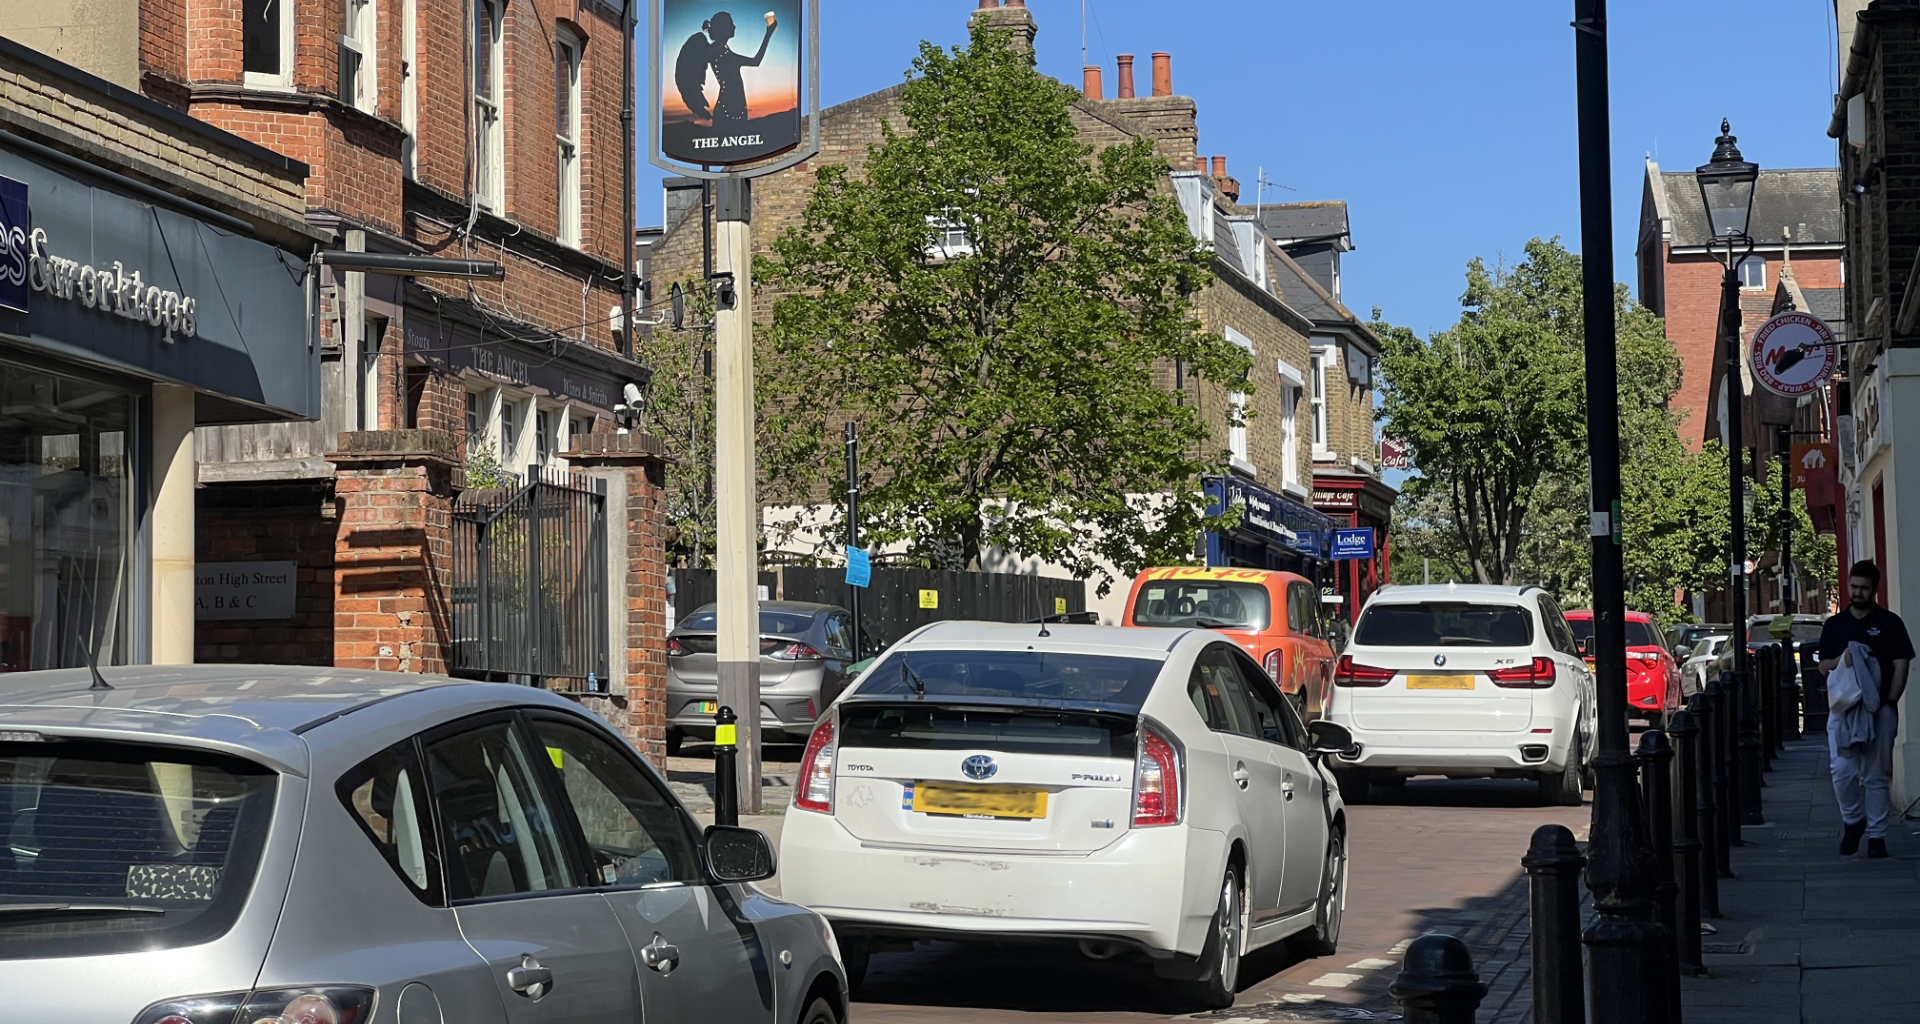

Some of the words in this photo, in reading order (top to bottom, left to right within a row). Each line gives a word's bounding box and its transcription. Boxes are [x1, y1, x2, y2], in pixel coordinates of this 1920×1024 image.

[692, 138, 719, 149] THE
[720, 134, 764, 147] ANGEL
[1775, 315, 1812, 327] CHICKEN
[407, 328, 431, 350] Stouts
[1757, 322, 1776, 344] FRIED
[1815, 324, 1828, 339] PIRI
[471, 346, 494, 374] THE
[496, 354, 531, 386] ANGEL
[1754, 351, 1763, 369] RIBS
[1760, 369, 1775, 385] BBQ
[563, 378, 581, 397] Wines
[582, 383, 587, 400] &
[588, 384, 608, 405] Spirits
[1778, 384, 1804, 392] WRAP
[1383, 454, 1405, 467] Cafe
[1336, 491, 1354, 502] Cafe
[1337, 533, 1366, 546] Lodge
[195, 576, 215, 586] ton
[219, 572, 249, 588] High
[252, 572, 287, 585] Street
[214, 595, 224, 609] B
[228, 595, 240, 608] &
[246, 595, 257, 608] C
[847, 764, 874, 772] TOYOTA
